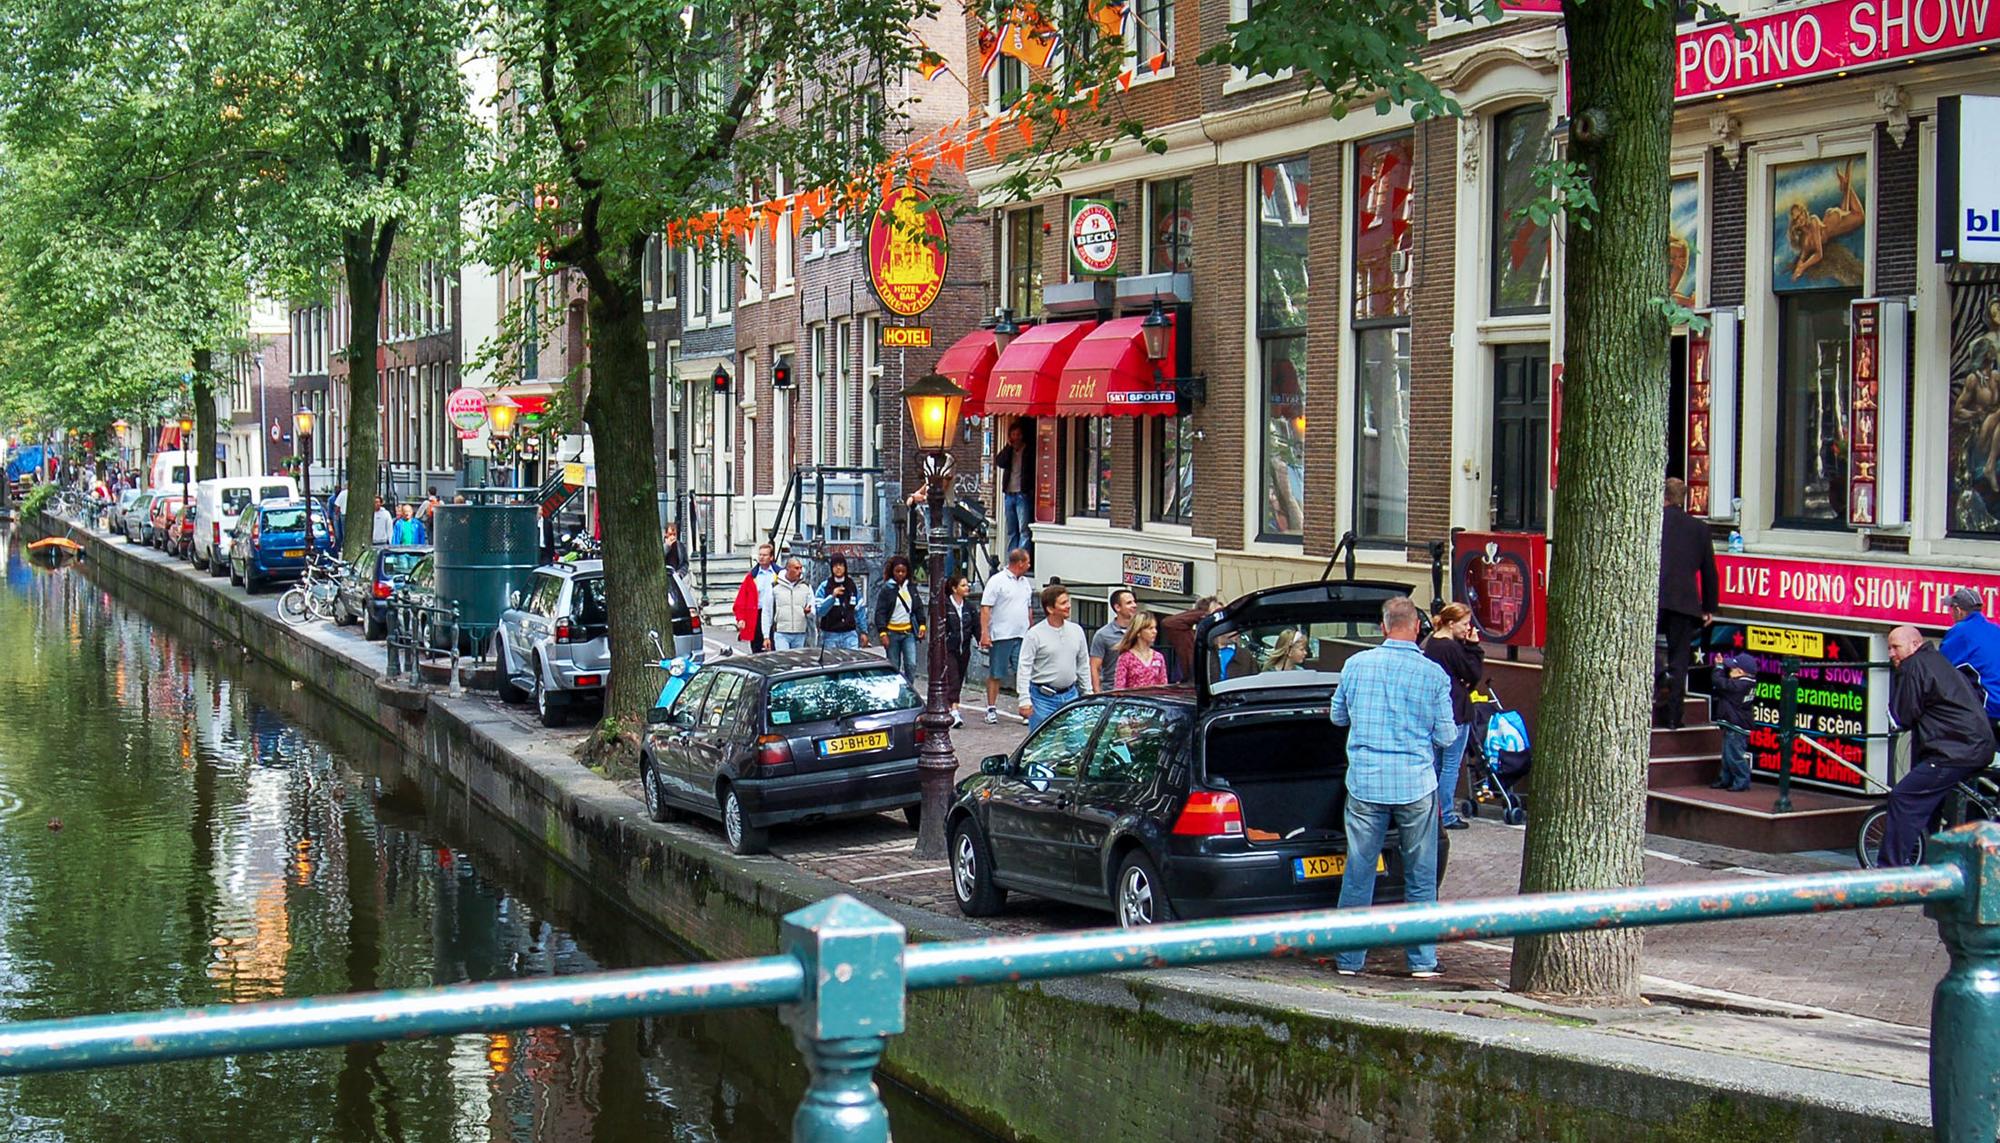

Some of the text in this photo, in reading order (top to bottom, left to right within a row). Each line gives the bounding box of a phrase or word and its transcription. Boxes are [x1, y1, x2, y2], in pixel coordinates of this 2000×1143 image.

[1679, 0, 1990, 90] PORNO SHOW
[880, 282, 937, 312] TORENZICHT
[894, 285, 921, 293] HOTEL
[886, 329, 929, 344] HOTEL
[996, 376, 1023, 398] Toren
[1128, 392, 1173, 401] SPORTS
[1141, 558, 1152, 572] BAR
[1725, 565, 1999, 618] LIVE PORNO SHOW THT
[1796, 687, 1863, 712] eramente
[1817, 714, 1862, 735] scène
